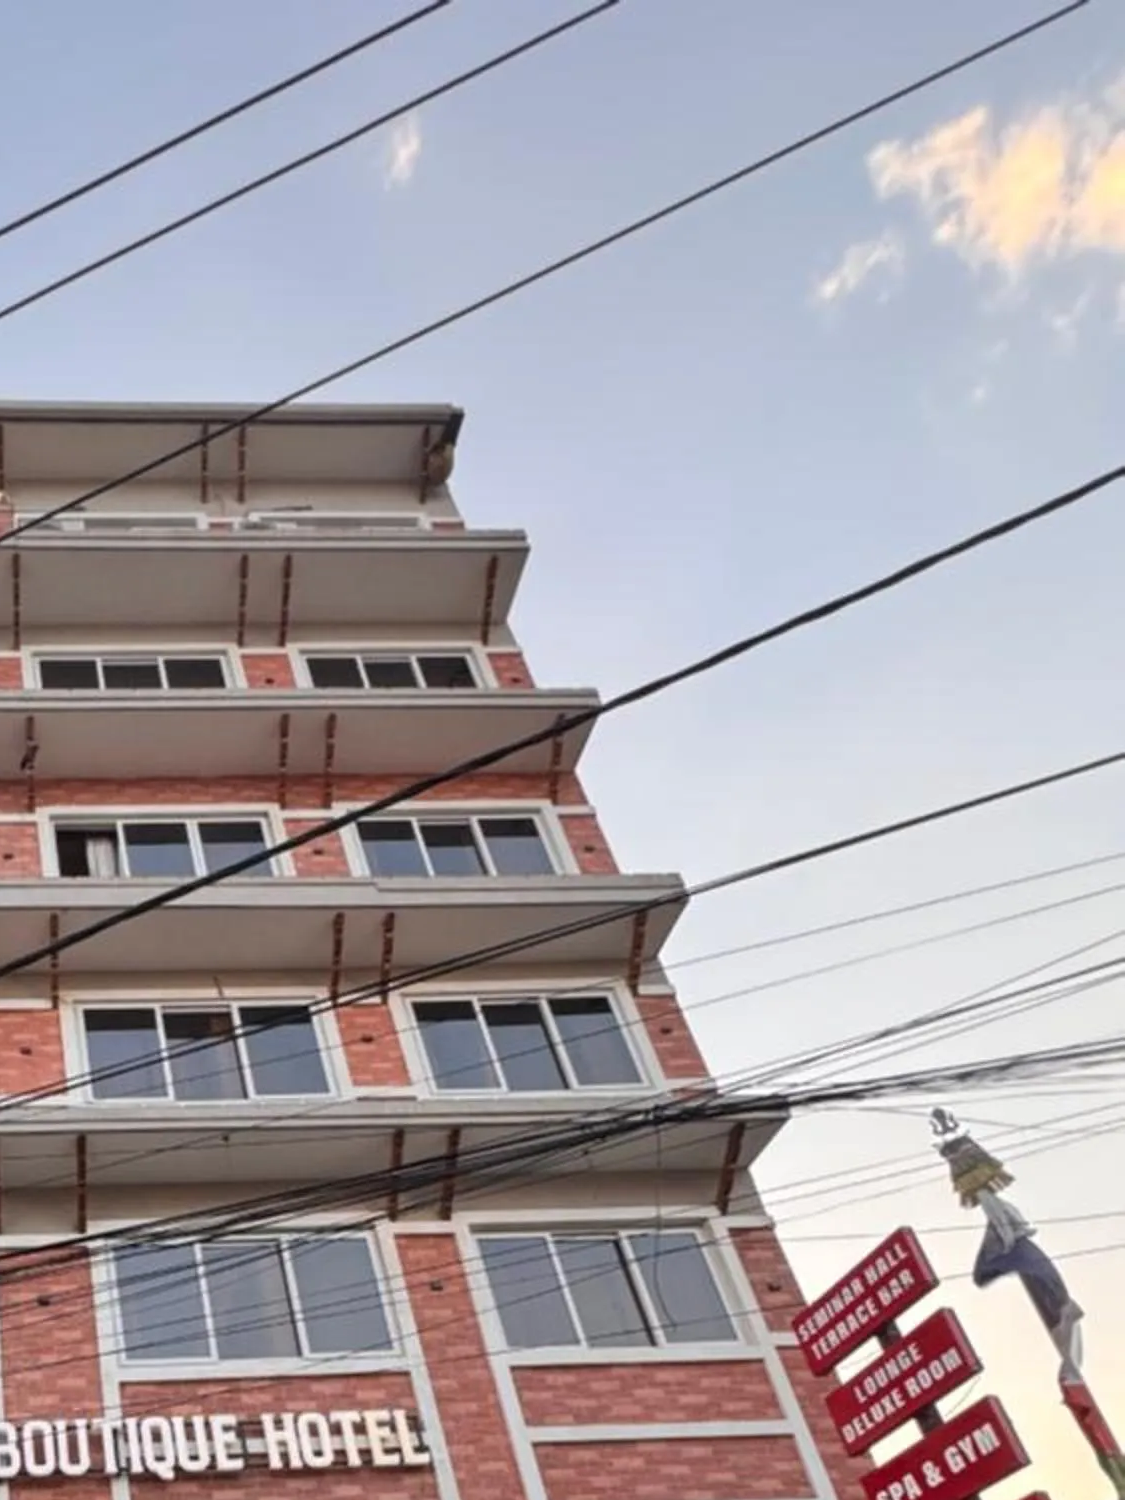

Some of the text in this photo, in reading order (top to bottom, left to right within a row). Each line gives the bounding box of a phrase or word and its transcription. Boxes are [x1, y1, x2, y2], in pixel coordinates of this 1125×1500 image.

[798, 1243, 908, 1342] SEMINAR HALL
[811, 1268, 914, 1360] TERRACE BAR
[841, 1346, 963, 1443] DELUXE ROOM
[853, 1342, 923, 1404] LOUNGE
[260, 1409, 431, 1471] HOTEL
[922, 1460, 946, 1488] &
[943, 1422, 1001, 1474] GYM
